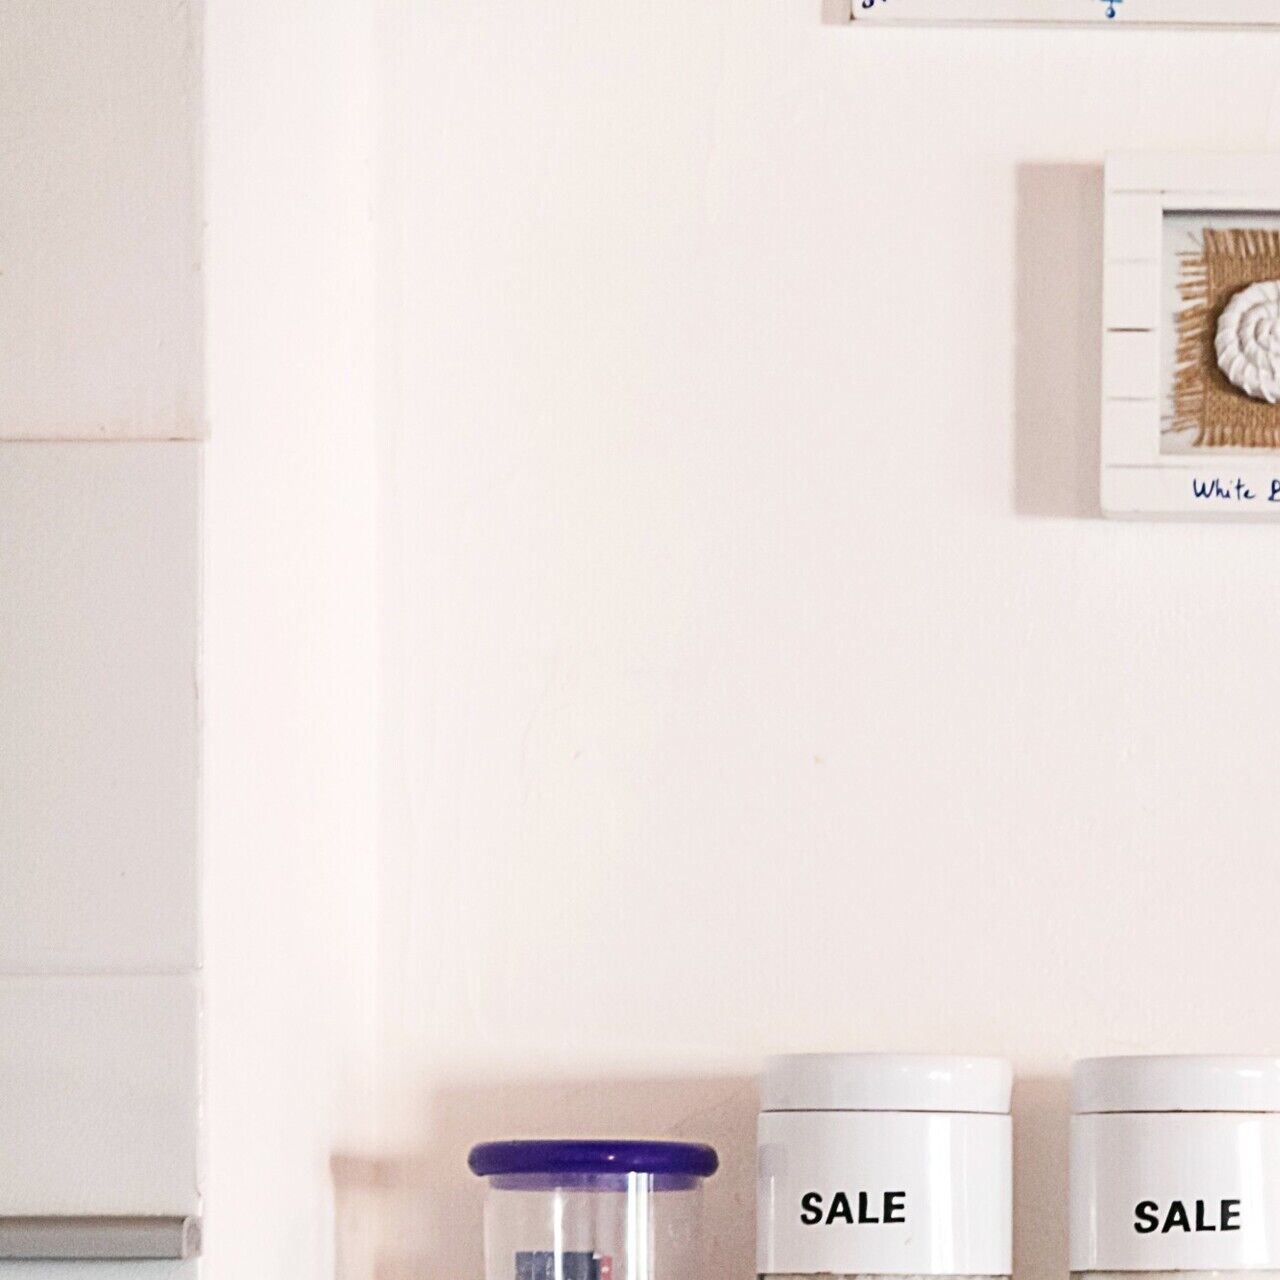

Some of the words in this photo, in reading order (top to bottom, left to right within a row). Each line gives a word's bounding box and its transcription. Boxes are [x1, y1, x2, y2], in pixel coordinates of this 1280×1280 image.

[1193, 478, 1256, 500] White
[799, 1191, 908, 1226] SALE
[1133, 1199, 1242, 1234] SALE
